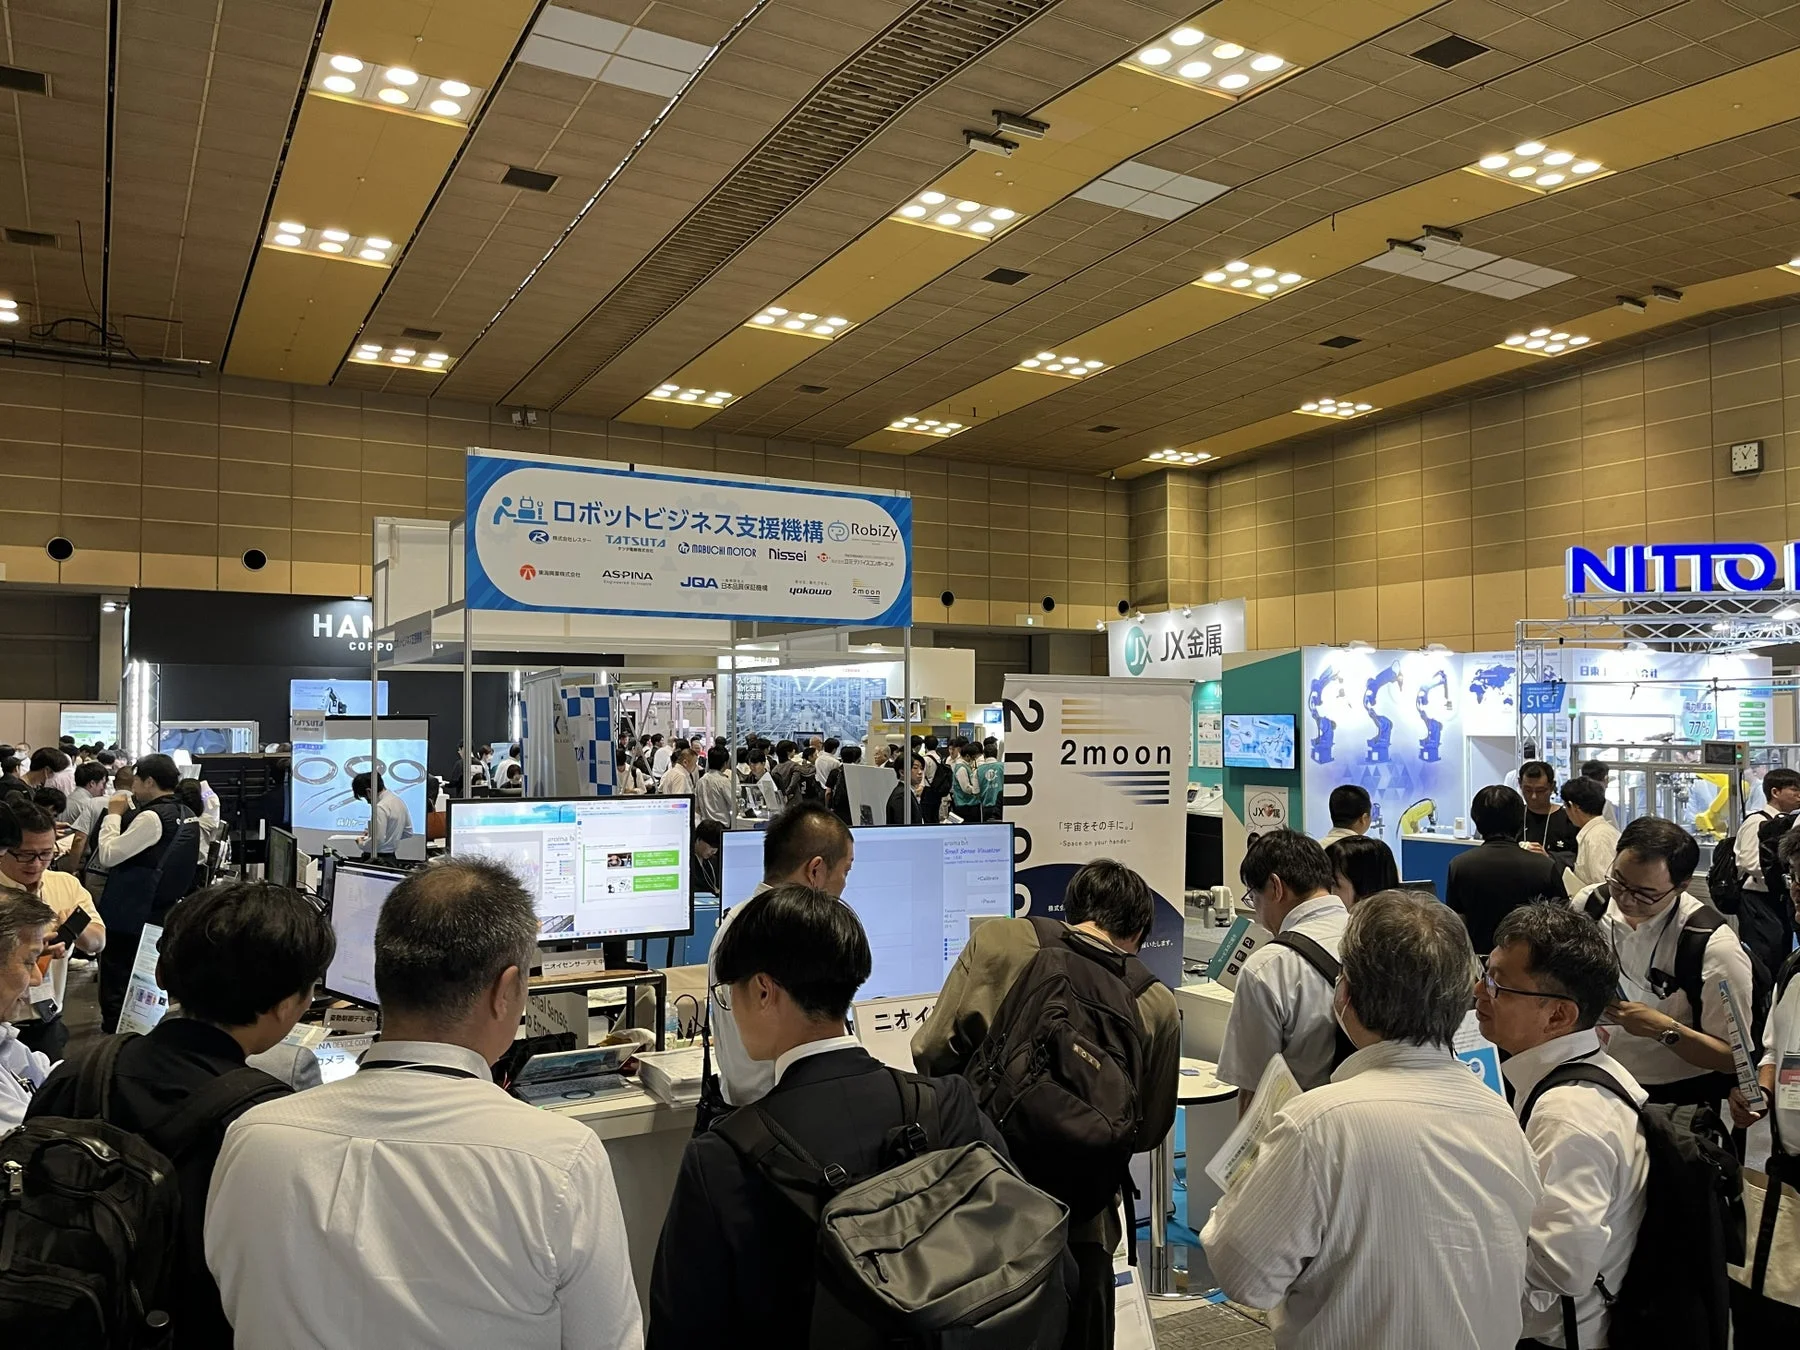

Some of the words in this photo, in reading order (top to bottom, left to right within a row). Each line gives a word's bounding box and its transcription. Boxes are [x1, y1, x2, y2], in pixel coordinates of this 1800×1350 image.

[553, 500, 824, 544] ロボットビジネス支援機構
[851, 523, 898, 541] RobiZy
[605, 534, 666, 548] TATSUTA
[692, 544, 725, 555] MABUCHI
[727, 546, 757, 557] MOTOR
[768, 548, 807, 561] Nissei
[602, 570, 653, 580] ASPINA
[1566, 543, 1777, 594] NITTO
[680, 577, 718, 588] JQA
[789, 586, 832, 596] yokowo
[852, 587, 880, 595] 2moon
[1161, 624, 1222, 662] JX金属
[1060, 740, 1171, 765] 2moon
